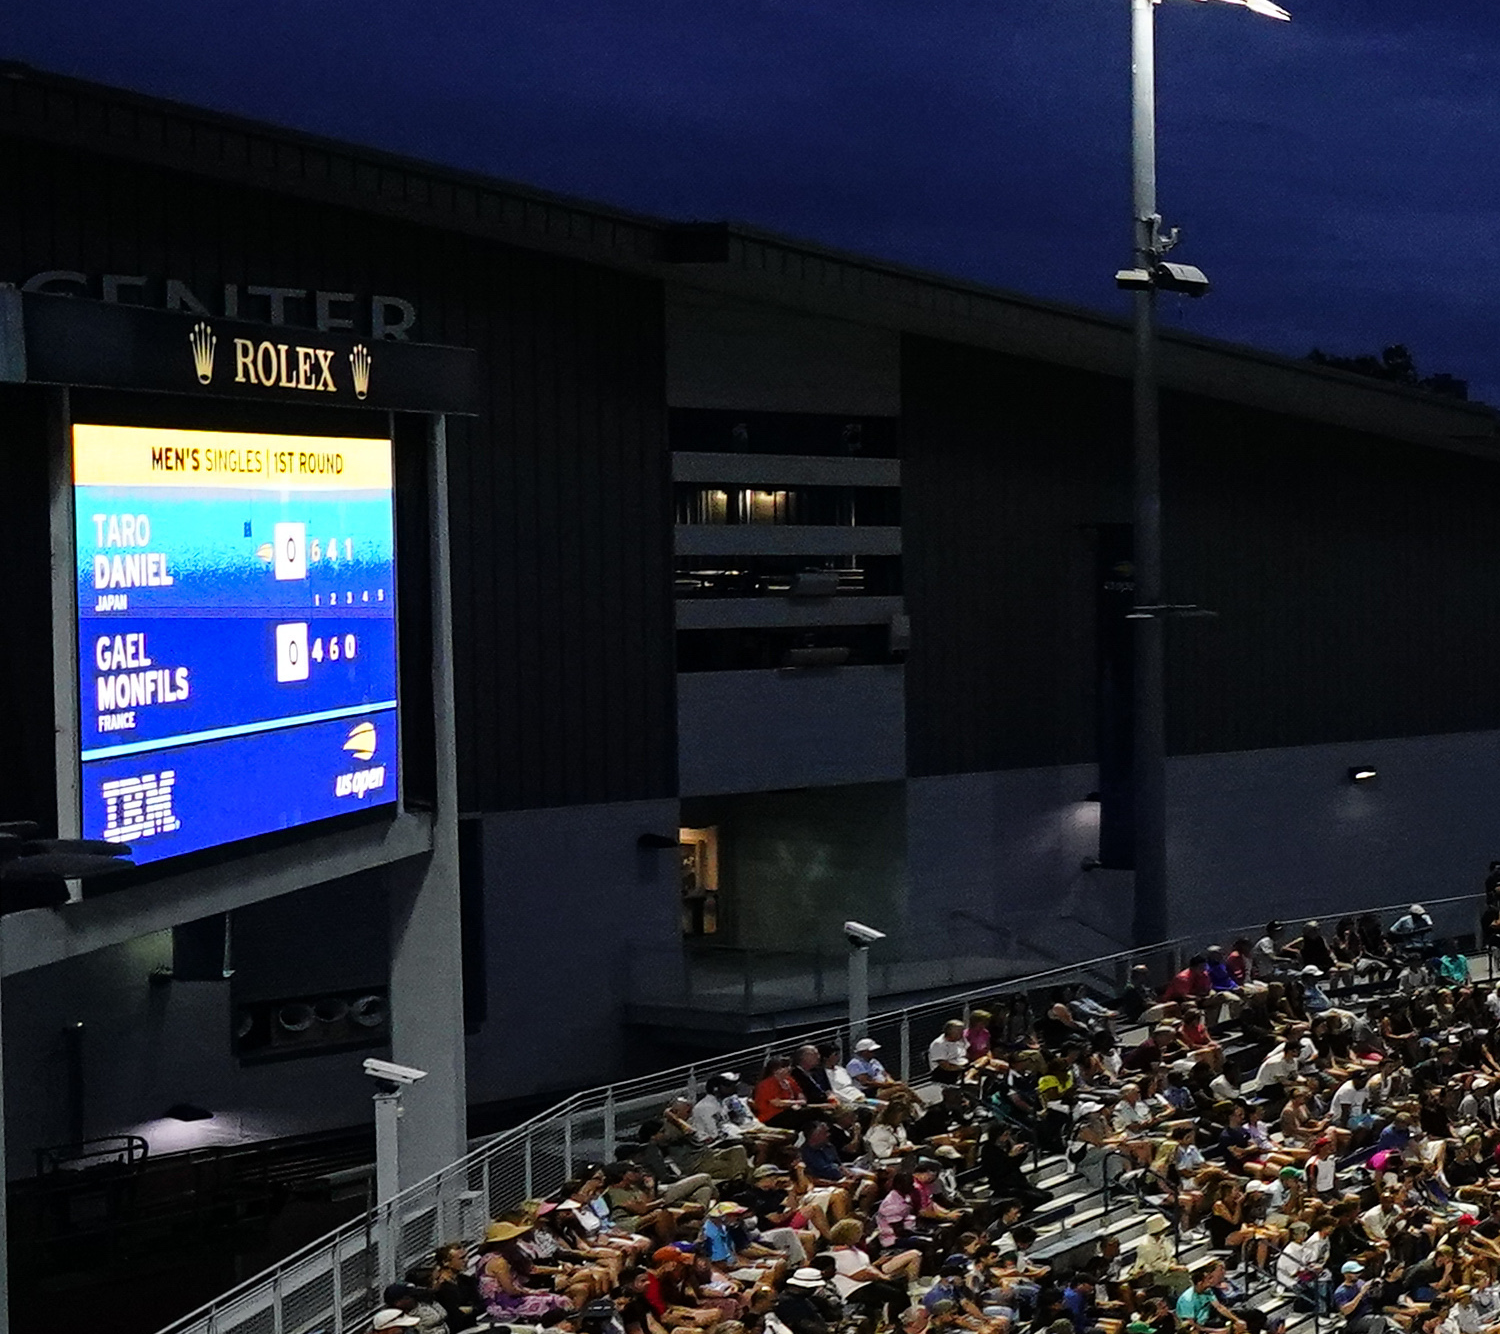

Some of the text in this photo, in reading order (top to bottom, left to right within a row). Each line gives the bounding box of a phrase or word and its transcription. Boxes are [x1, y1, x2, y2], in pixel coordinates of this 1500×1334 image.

[234, 338, 337, 392] ROLEX
[151, 447, 343, 474] MEN'S SINGLES 1ST ROUND
[93, 514, 148, 547] TARO
[94, 553, 173, 589] DANIEL
[95, 594, 127, 611] JAPAN
[96, 632, 151, 670] GAEL
[311, 638, 323, 662] 4
[97, 667, 189, 711] MONFILS
[98, 712, 136, 732] FRANCE
[102, 770, 176, 843] IBM
